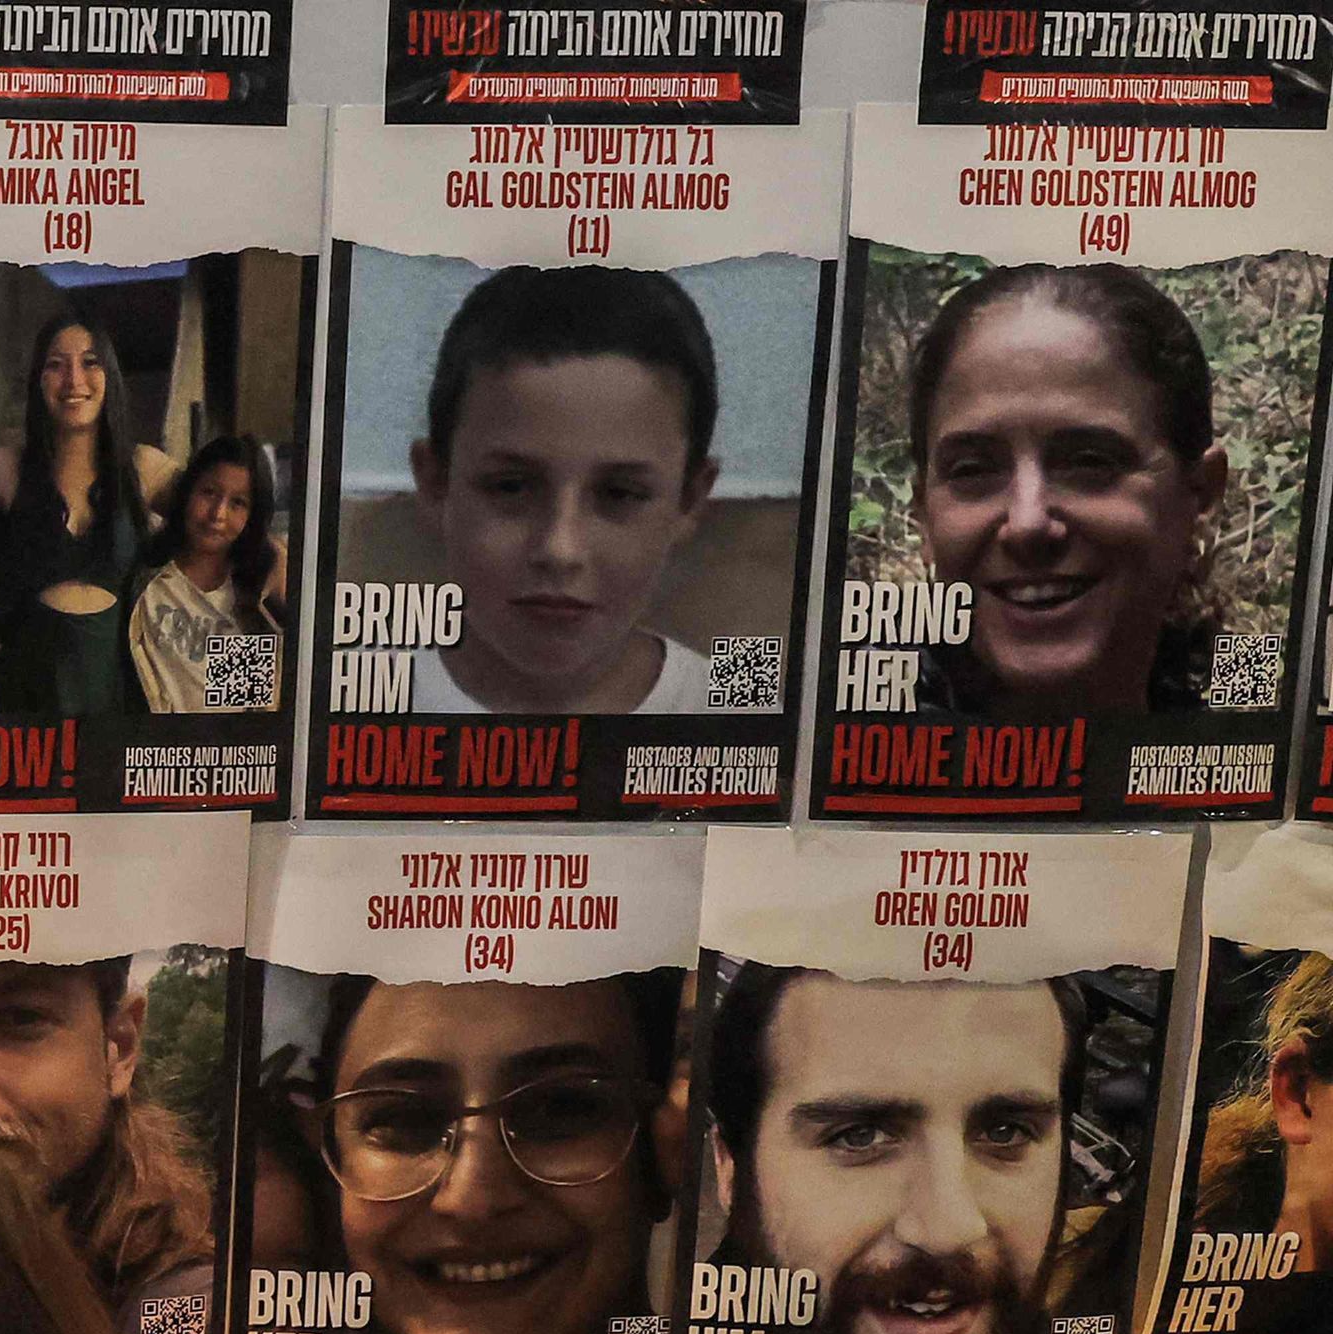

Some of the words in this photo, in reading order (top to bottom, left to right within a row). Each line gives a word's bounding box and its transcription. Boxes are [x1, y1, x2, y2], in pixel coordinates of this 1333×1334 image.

[5, 120, 64, 160] אנגל
[74, 123, 137, 164] מיקה
[470, 124, 546, 165] אלמוג
[554, 124, 677, 167] גולדשטיין
[687, 125, 714, 165] גל
[986, 124, 1059, 161] אלמוג
[1066, 126, 1190, 166] גולדשטיין
[1198, 128, 1225, 166] חן
[65, 168, 143, 206] ANGEL
[447, 170, 493, 208] GAL
[502, 170, 635, 211] GOLDSTEIN
[643, 172, 731, 211] ALMOG
[960, 168, 1024, 205] CHEN
[1031, 169, 1164, 208] GOLDSTEIN
[1170, 171, 1257, 208] ALMOG
[44, 212, 91, 253] (18)
[569, 216, 611, 256] (11)
[1080, 213, 1130, 254] (49)
[29, 832, 72, 867] רוני
[901, 849, 970, 888] גולדין
[403, 853, 462, 889] אלוני
[471, 853, 527, 892] קוניו
[535, 855, 589, 892] שרון
[978, 850, 1029, 890] אורן
[0, 873, 79, 908] KRIVOI
[876, 892, 938, 925] OREN
[945, 892, 1029, 928] GOLDIN
[369, 895, 462, 928] SHARON
[471, 896, 542, 928] KONIO
[548, 896, 617, 929] ALONI
[466, 933, 514, 971] (34)
[924, 933, 974, 972] (34)
[690, 1262, 816, 1325] BRING
